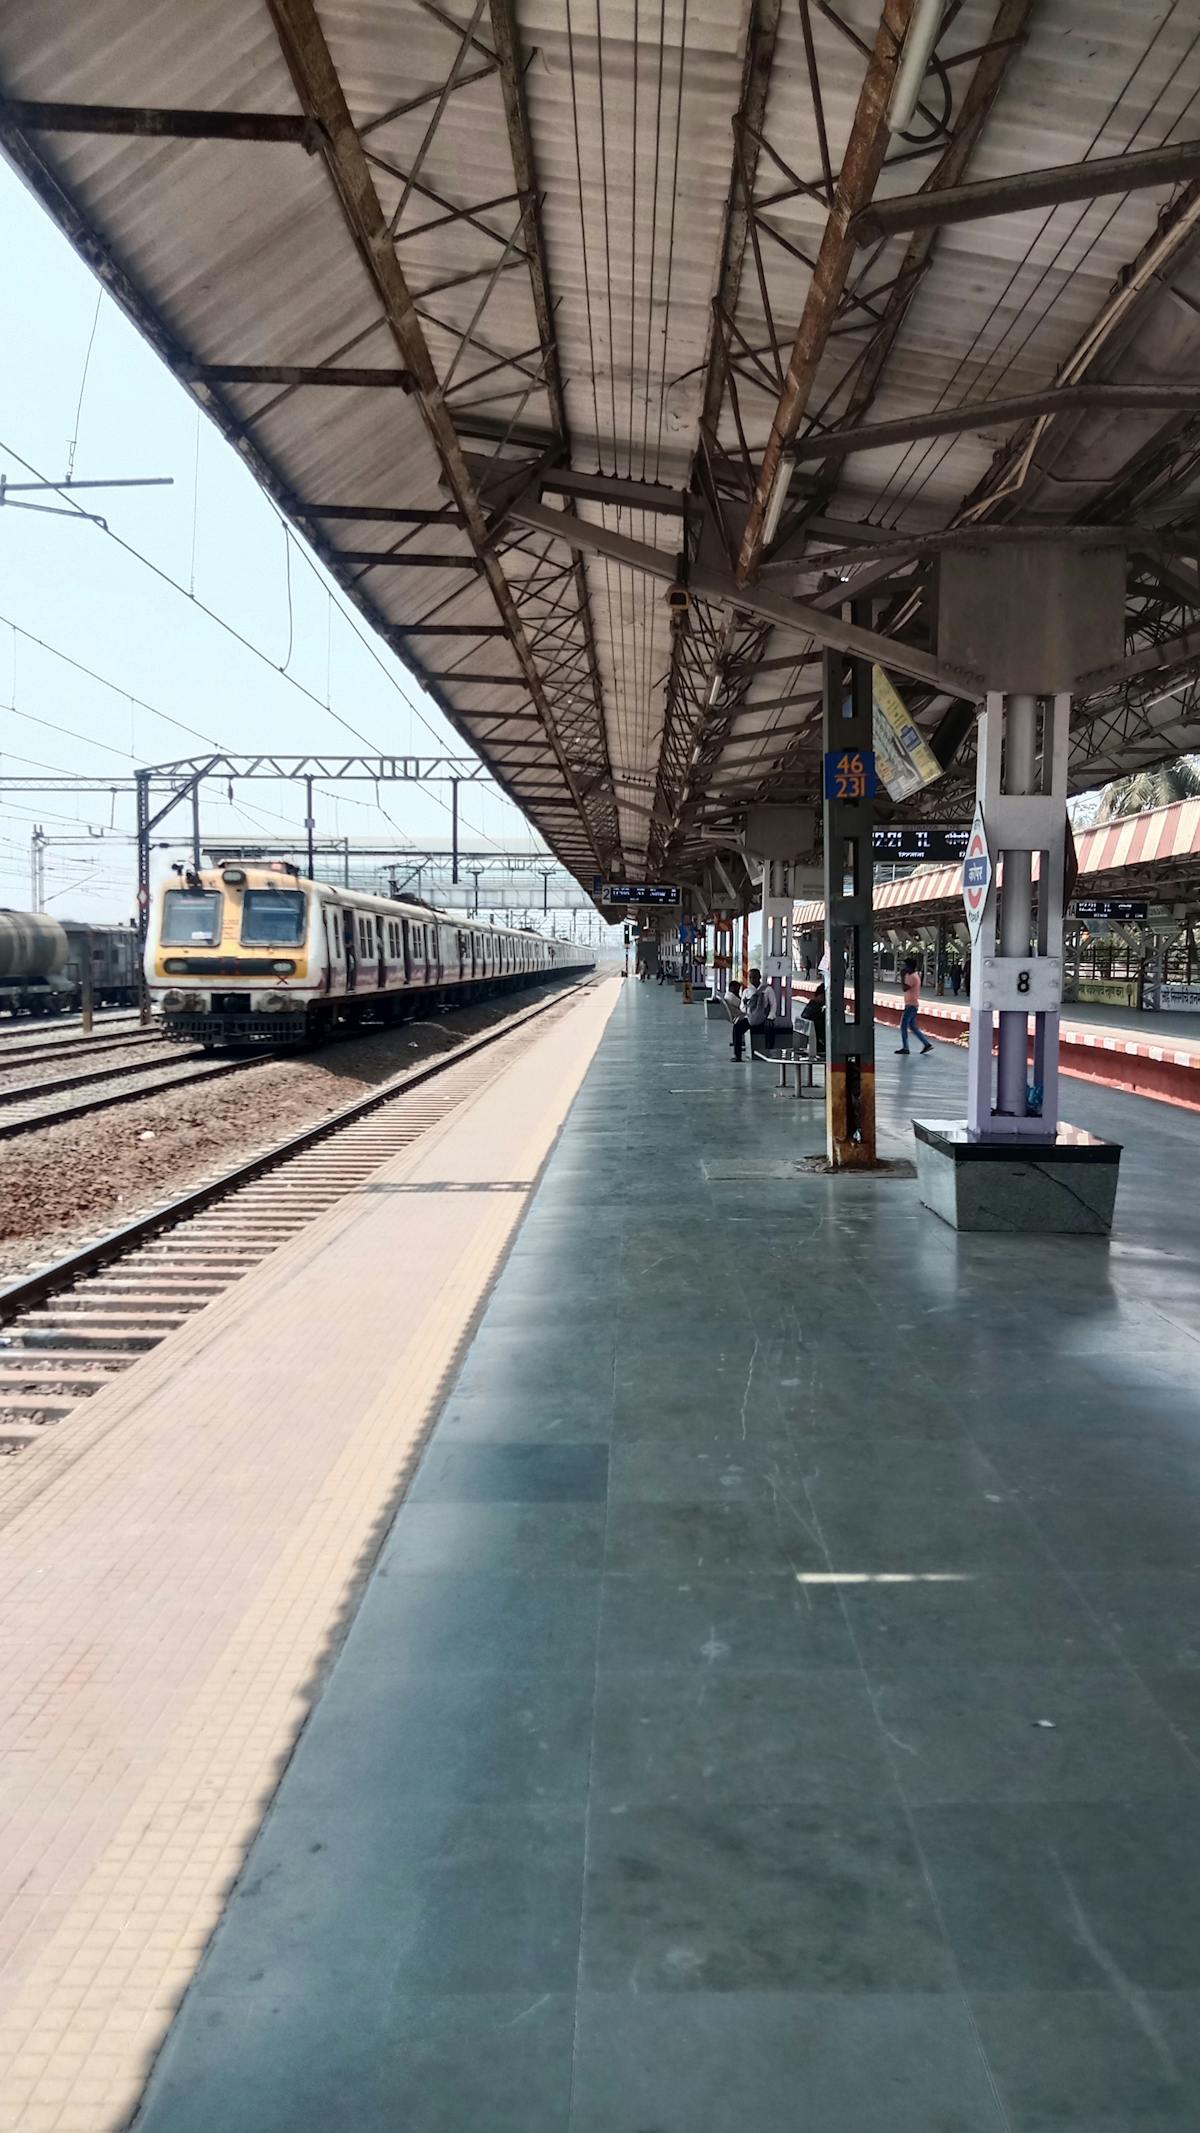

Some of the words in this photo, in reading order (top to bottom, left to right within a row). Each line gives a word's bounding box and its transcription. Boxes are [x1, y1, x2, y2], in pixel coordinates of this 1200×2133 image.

[836, 753, 864, 774] 46
[835, 777, 865, 798] 231
[603, 888, 610, 900] 2
[1017, 971, 1030, 993] 8
